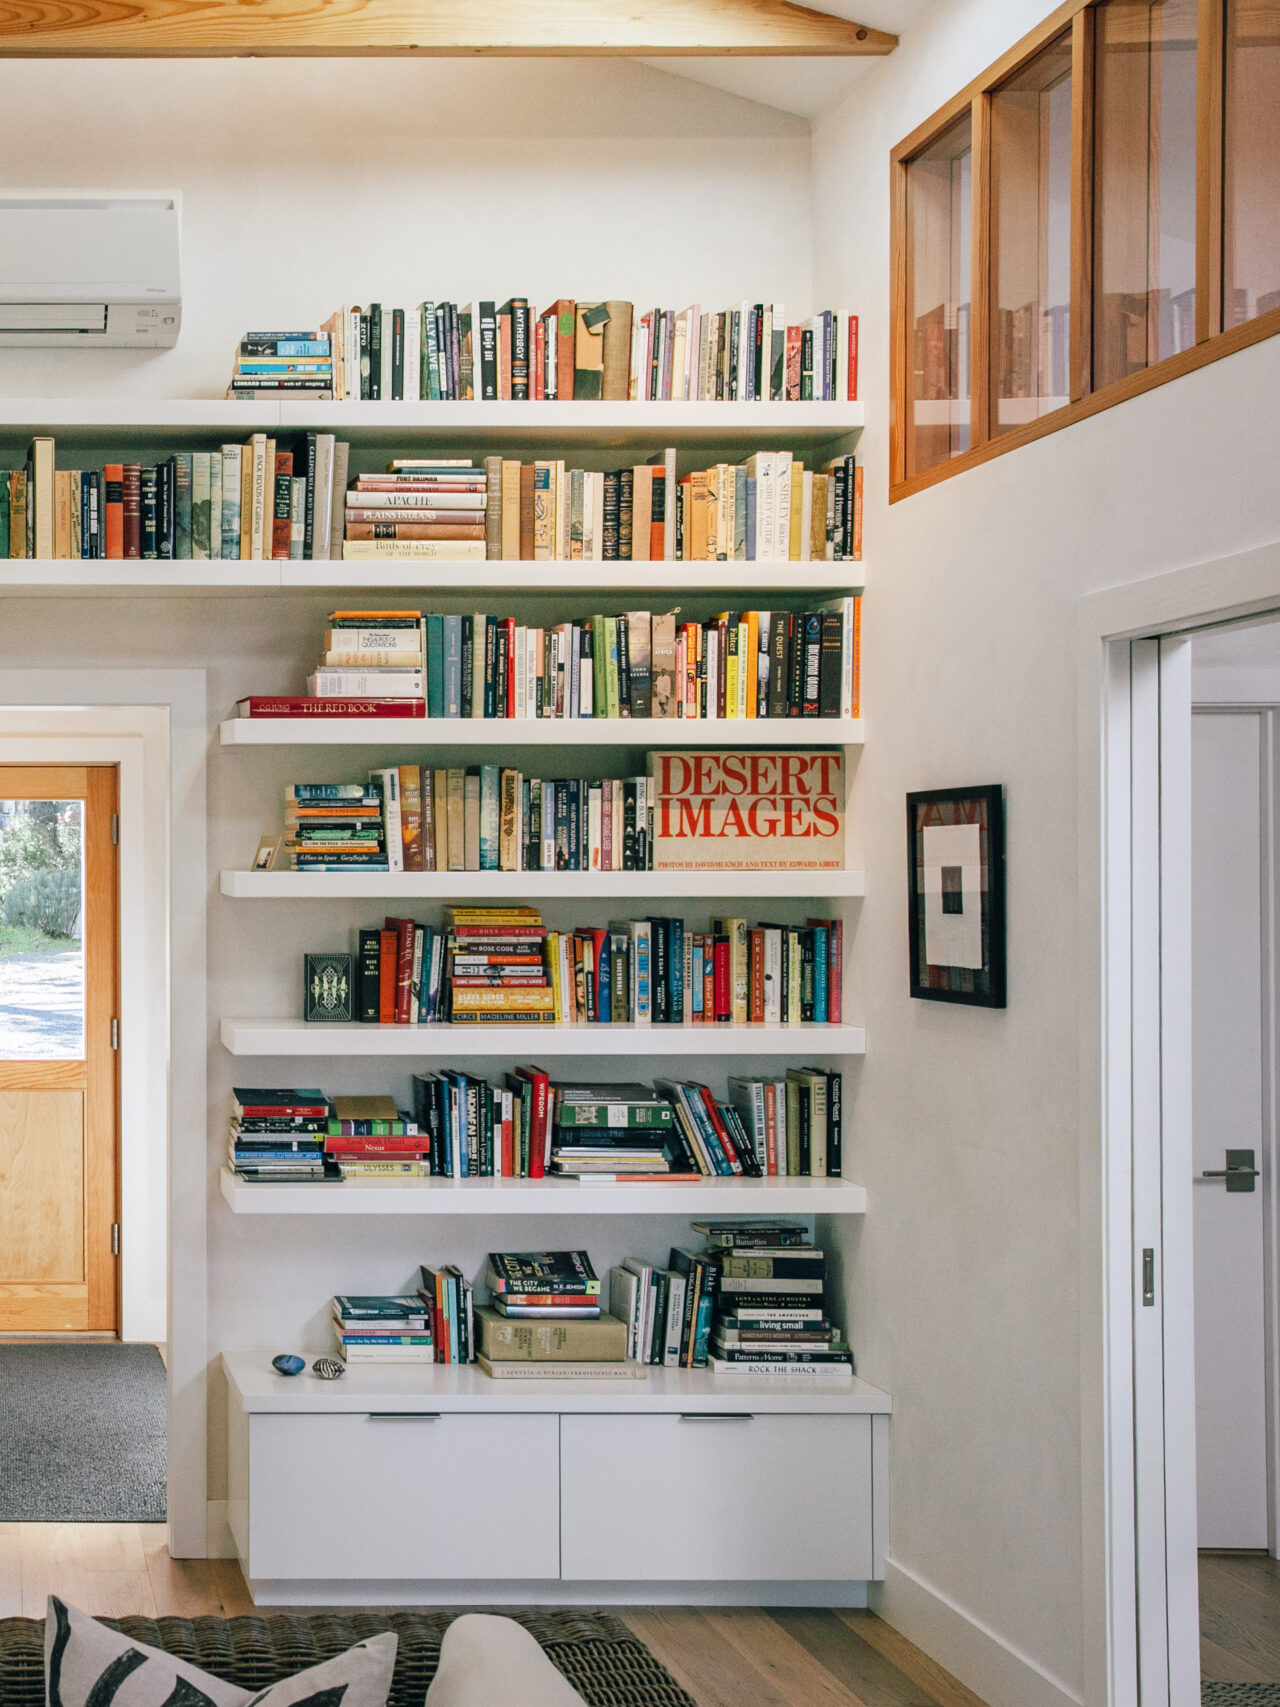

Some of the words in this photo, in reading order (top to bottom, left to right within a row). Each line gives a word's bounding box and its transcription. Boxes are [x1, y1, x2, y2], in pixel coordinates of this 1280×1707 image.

[425, 303, 436, 337] FULLY
[516, 309, 524, 359] MYTHOLOGY
[427, 339, 437, 371] ALIVE
[384, 495, 432, 506] APACHE
[780, 484, 789, 521] SIBLEY
[363, 511, 395, 519] PLAINS
[396, 511, 436, 519] INDIANS
[376, 542, 399, 551] Birds
[729, 628, 737, 653] Falter
[776, 636, 784, 659] QUEST
[808, 645, 820, 675] UNCOMMON
[806, 676, 820, 700] GROUND
[301, 704, 325, 713] THE
[326, 704, 346, 713] RED
[348, 704, 376, 713] BOOK
[658, 755, 840, 795] DESERT
[657, 797, 839, 838] IMAGES
[537, 1082, 545, 1118] WIFEDOM
[755, 1085, 764, 1103] STACEY
[832, 1077, 841, 1103] Creative
[467, 1089, 477, 1135] WOMEN
[755, 1103, 764, 1126] ABRAMS
[832, 1103, 841, 1122] Quest
[755, 1127, 764, 1136] OUR
[755, 1136, 764, 1148] TIME
[364, 1144, 385, 1152] Nexus
[363, 1164, 395, 1172] ULYSSES
[707, 1267, 717, 1293] Blake
[759, 1320, 783, 1330] living
[783, 1320, 804, 1330] small
[734, 1352, 760, 1362] Patterns
[766, 1352, 784, 1362] Home
[748, 1365, 767, 1374] ROCK
[768, 1365, 784, 1374] THE
[786, 1365, 818, 1374] SHACK
